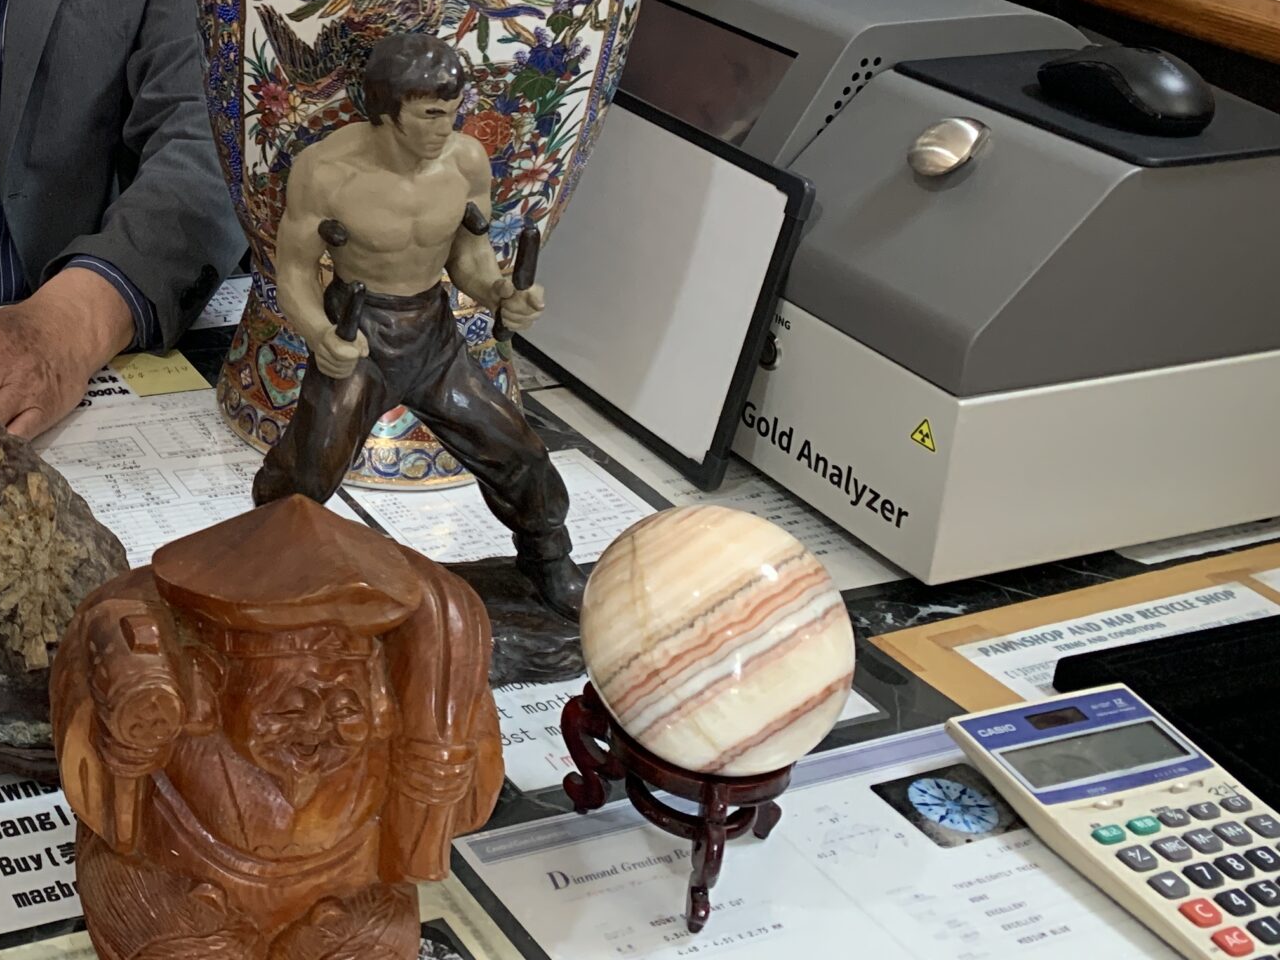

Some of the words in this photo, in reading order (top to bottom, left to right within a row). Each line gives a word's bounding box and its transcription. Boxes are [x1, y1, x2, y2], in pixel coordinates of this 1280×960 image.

[773, 313, 791, 331] ING
[741, 400, 794, 454] Gold
[796, 439, 909, 529] Analyzer
[978, 629, 1064, 658] PAWNSHOP
[1066, 620, 1103, 641] AND
[1100, 612, 1135, 633] MAP
[1136, 599, 1200, 620] RECYCLE
[1195, 589, 1237, 606] SHOP
[1053, 639, 1085, 653] TERMS
[1087, 634, 1108, 646] AND
[1108, 622, 1167, 641] CONDITIONS
[977, 723, 1017, 739] CASIO
[1226, 857, 1246, 872] 8
[1256, 850, 1275, 864] 9
[547, 864, 620, 891] Diamond
[621, 851, 673, 872] Grading
[1195, 865, 1212, 880] 7
[12, 880, 77, 909] magb
[1258, 883, 1277, 898] 5
[1229, 892, 1247, 907] 4
[1194, 903, 1214, 918] C
[1261, 920, 1278, 935] 1
[1224, 930, 1249, 948] AC
